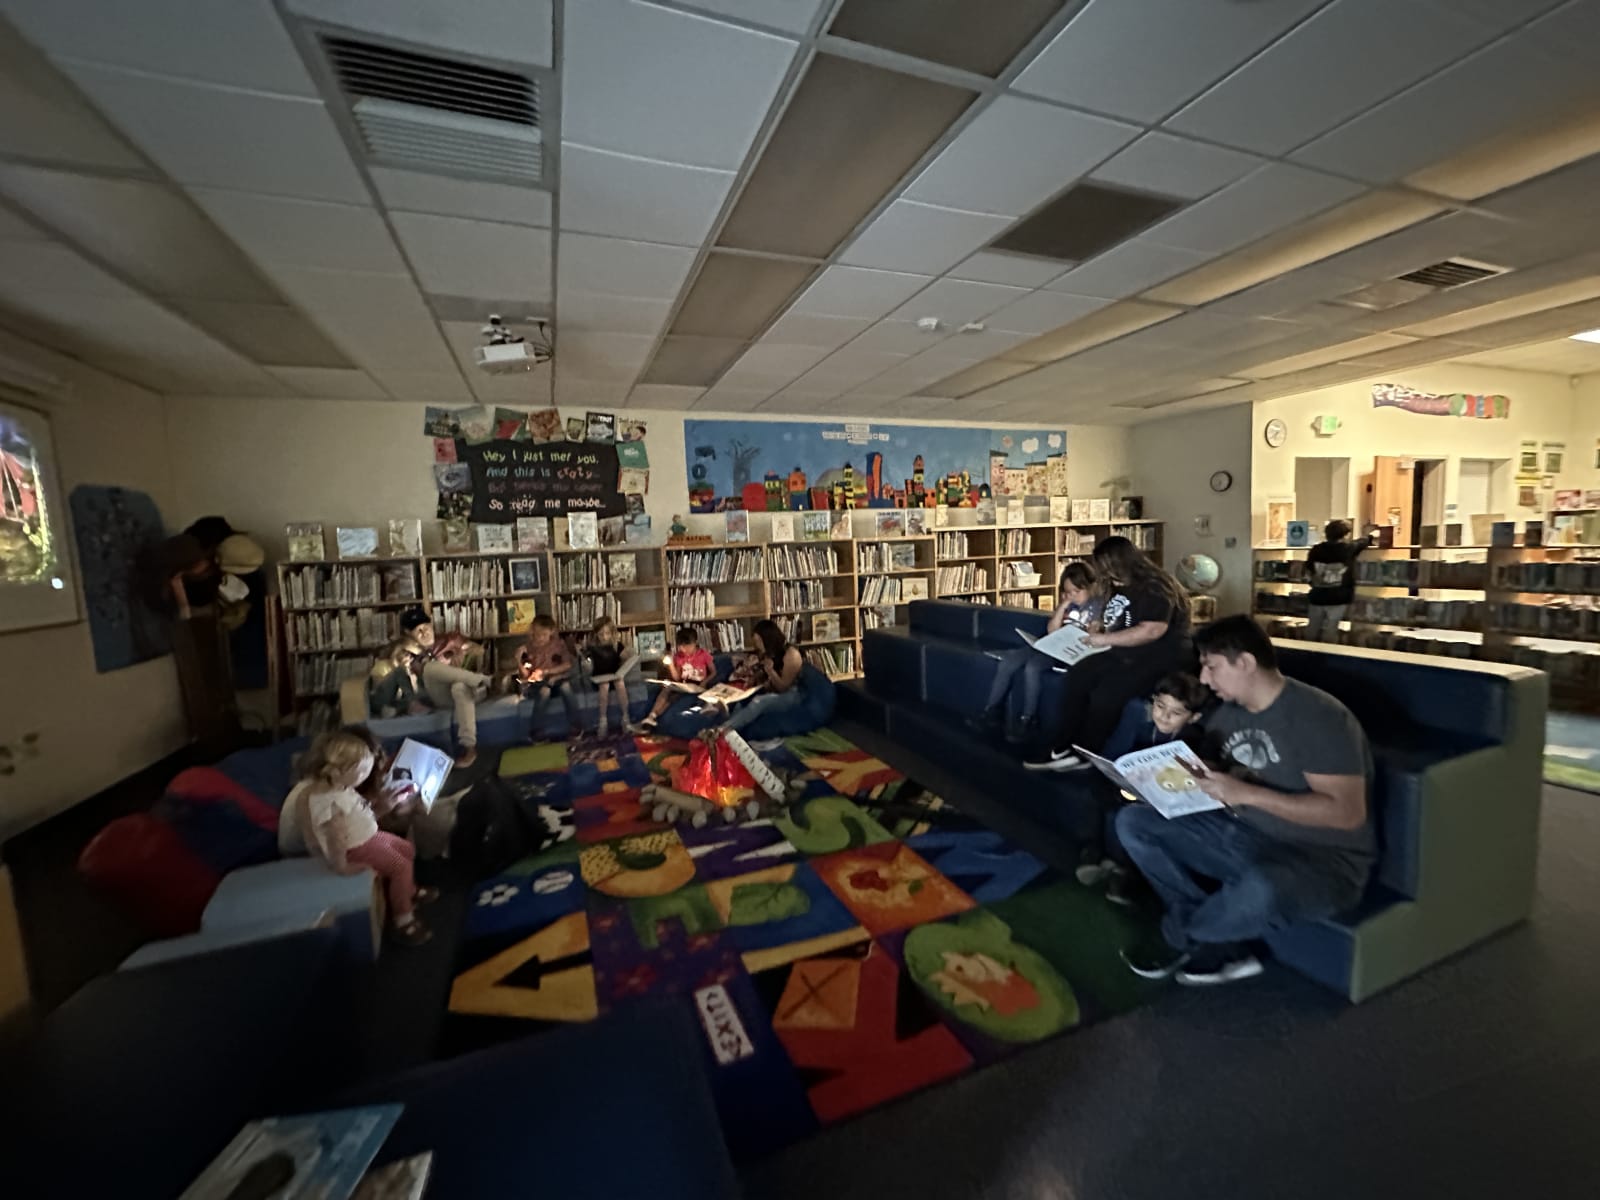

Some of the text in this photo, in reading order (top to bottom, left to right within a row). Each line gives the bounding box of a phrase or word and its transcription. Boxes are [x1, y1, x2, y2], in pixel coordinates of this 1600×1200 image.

[482, 449, 506, 463] Hey
[512, 448, 517, 461] I
[523, 450, 544, 463] just
[486, 466, 508, 478] And
[514, 466, 536, 478] this
[540, 467, 551, 477] is
[488, 498, 504, 511] So
[544, 498, 561, 509] me
